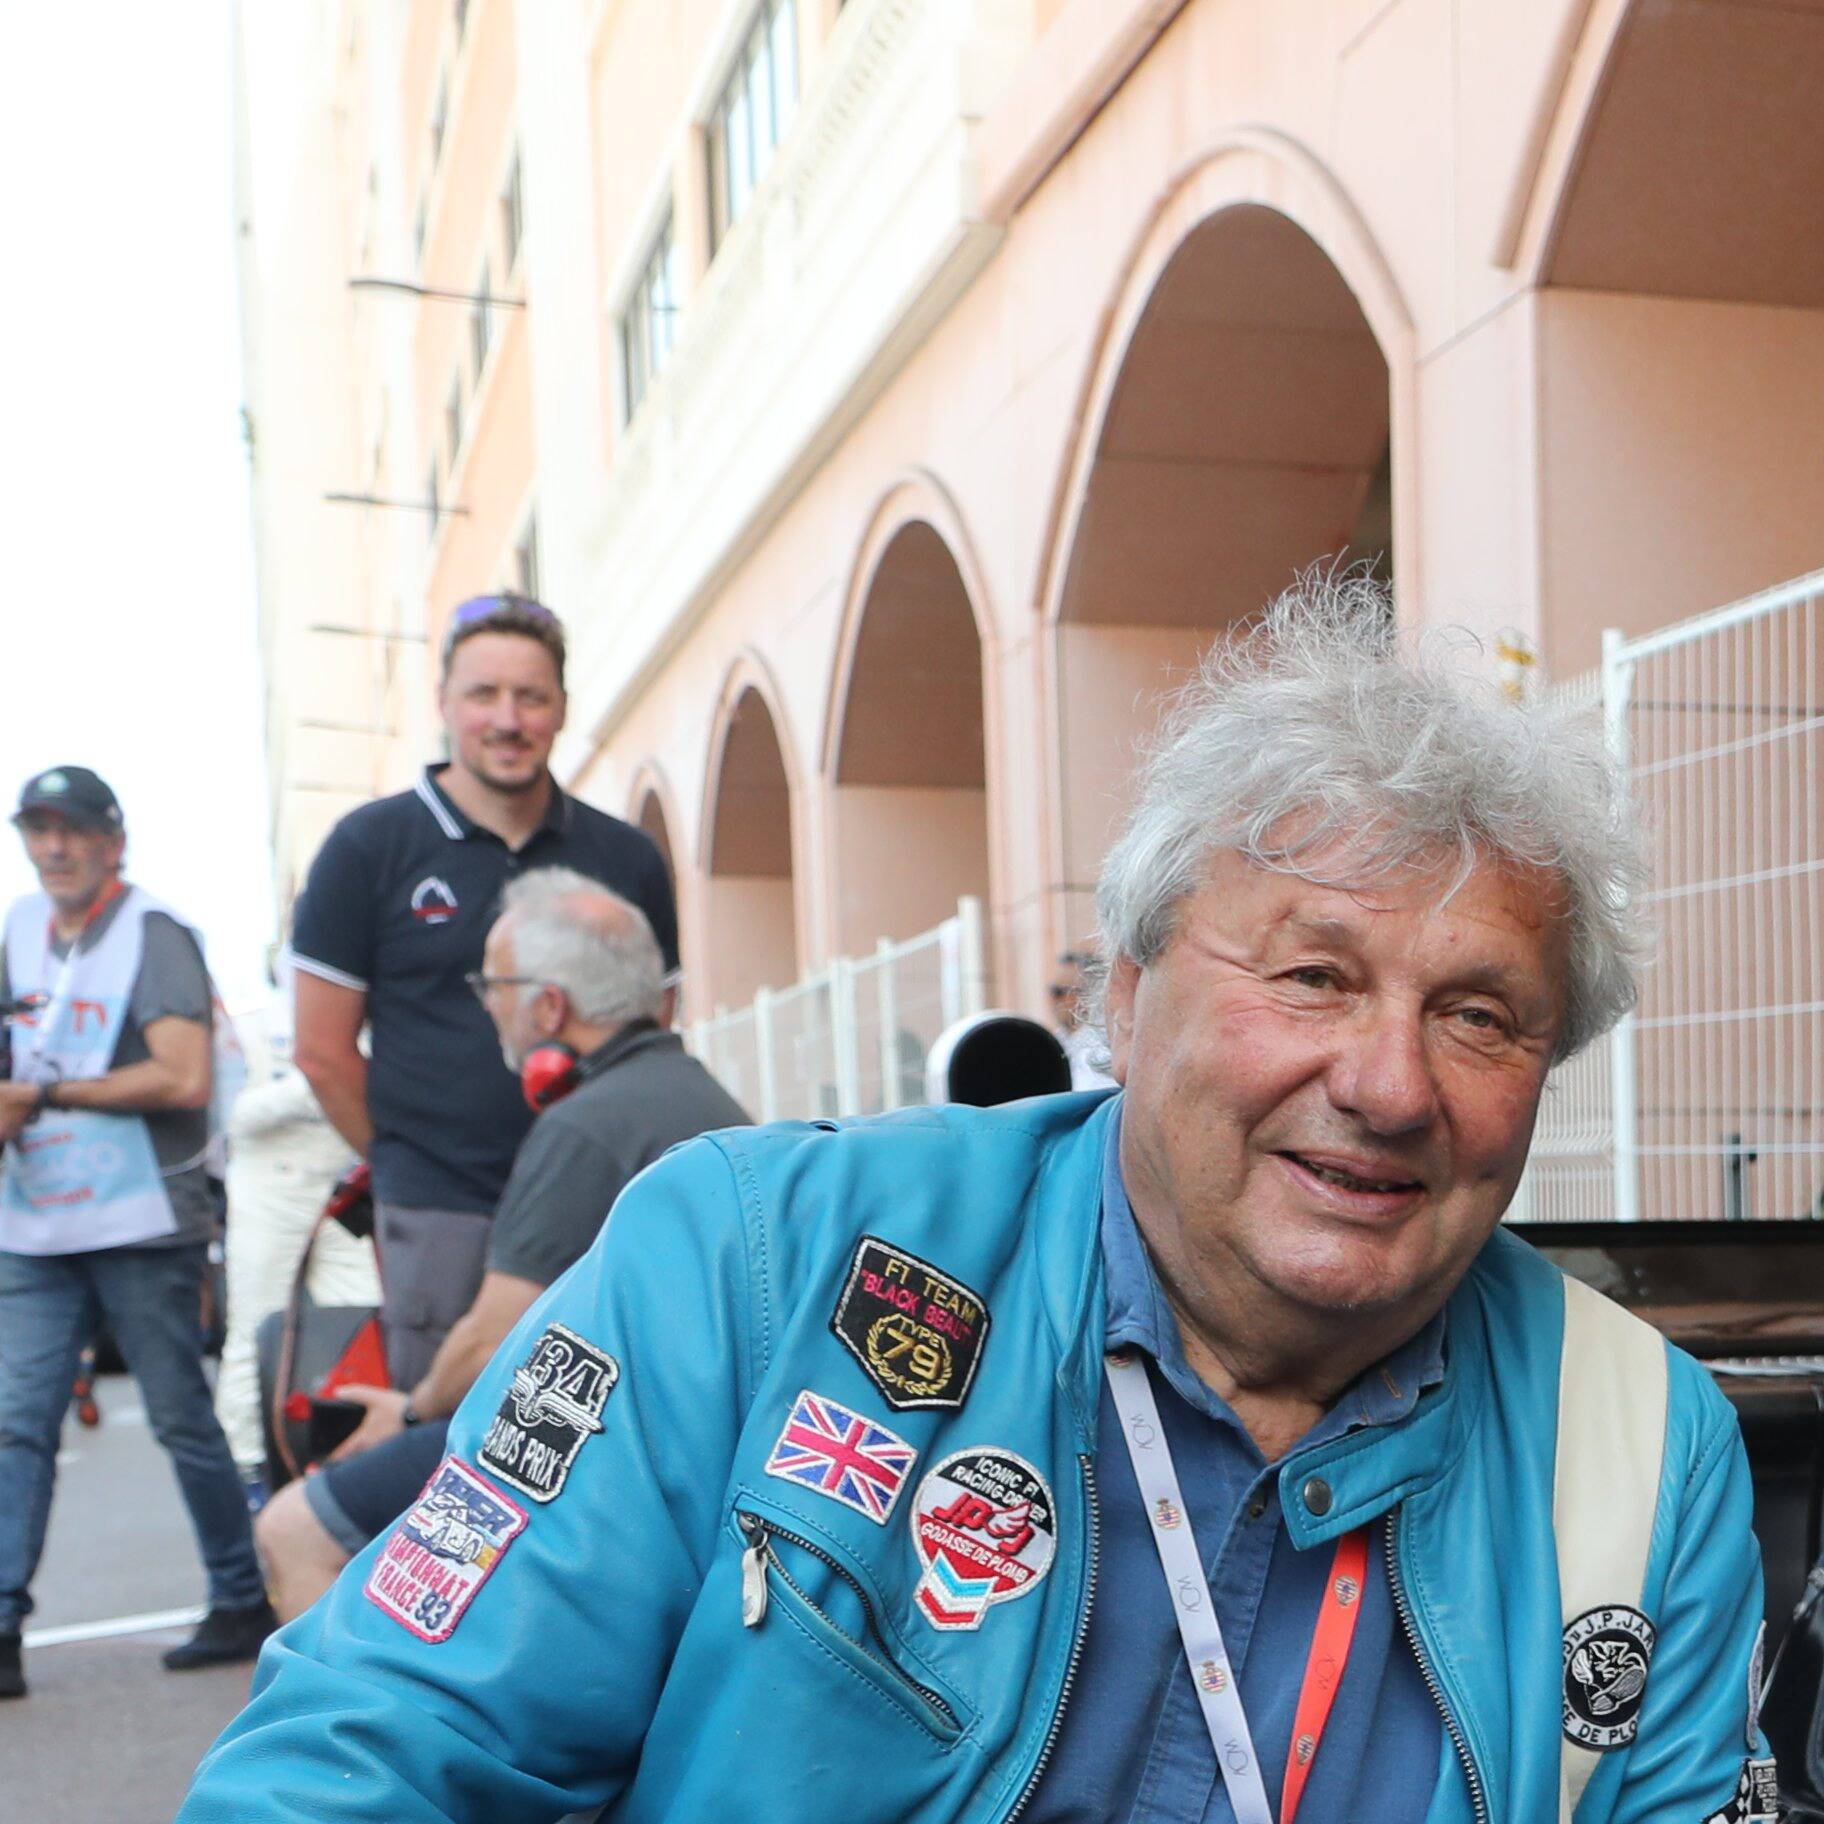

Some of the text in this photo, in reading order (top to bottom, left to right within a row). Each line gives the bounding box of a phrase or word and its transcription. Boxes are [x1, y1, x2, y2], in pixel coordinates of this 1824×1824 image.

[884, 1257, 978, 1324] F1 TEAM
[898, 1314, 942, 1349] TYPE
[882, 1327, 942, 1380] 79
[518, 1437, 563, 1490] PRIX
[975, 1456, 1023, 1490] ICONIC
[920, 1521, 978, 1556] GODASSE
[971, 1543, 991, 1565] DE
[413, 1589, 452, 1631] 93
[1578, 1720, 1637, 1744] DE PLO
